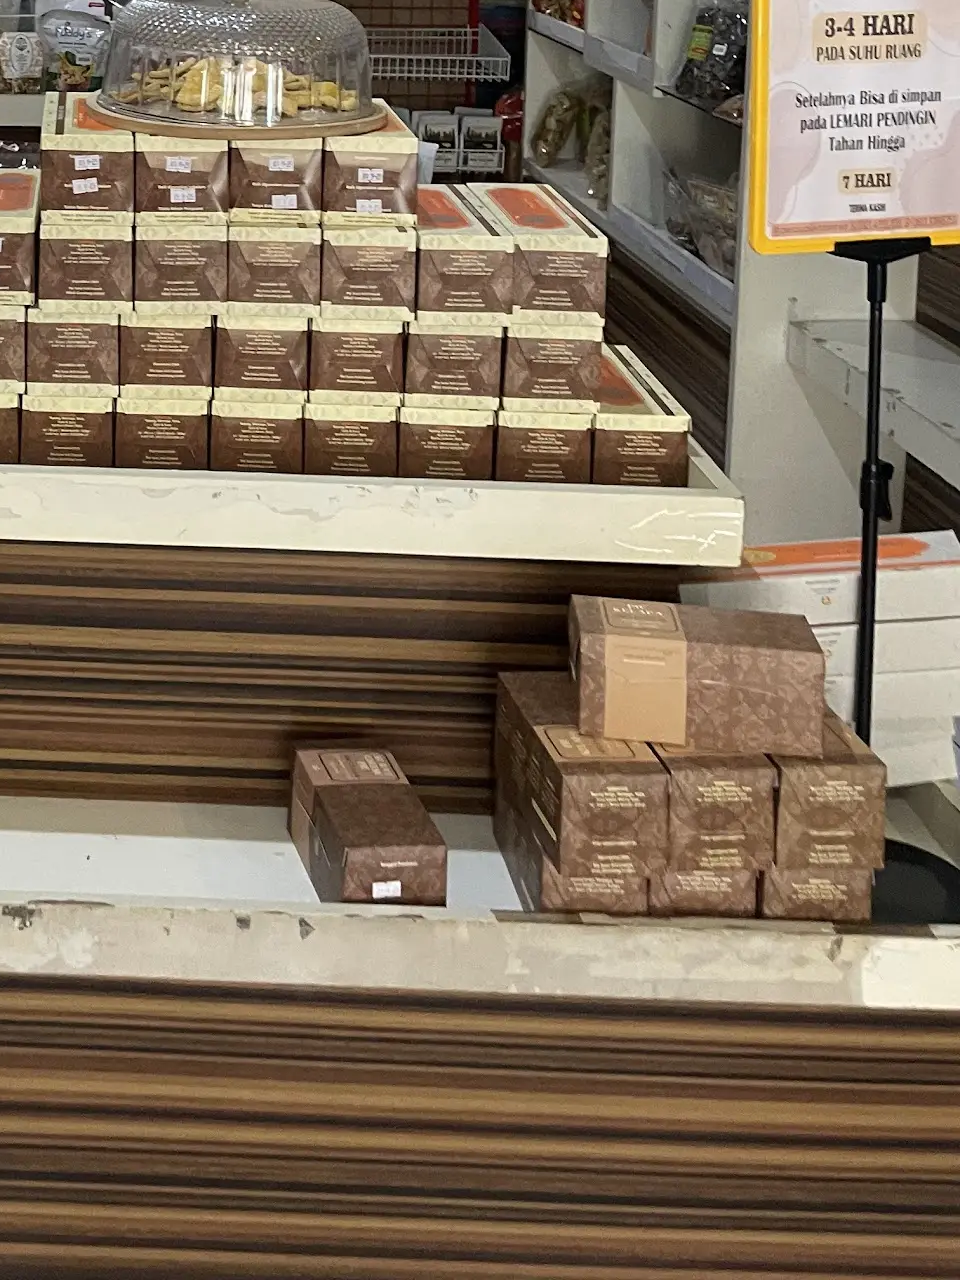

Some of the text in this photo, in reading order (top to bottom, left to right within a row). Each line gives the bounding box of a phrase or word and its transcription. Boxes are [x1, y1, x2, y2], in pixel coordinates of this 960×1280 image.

[824, 13, 915, 38] 3-4 HARI
[815, 43, 922, 62] PADA SUHU RUANG
[794, 89, 942, 110] Setelahnya Bisa di simpan
[800, 109, 937, 134] pada LEMARI PENDINGIN
[828, 134, 906, 153] Tahan Hingga
[842, 172, 892, 190] 7 HARI
